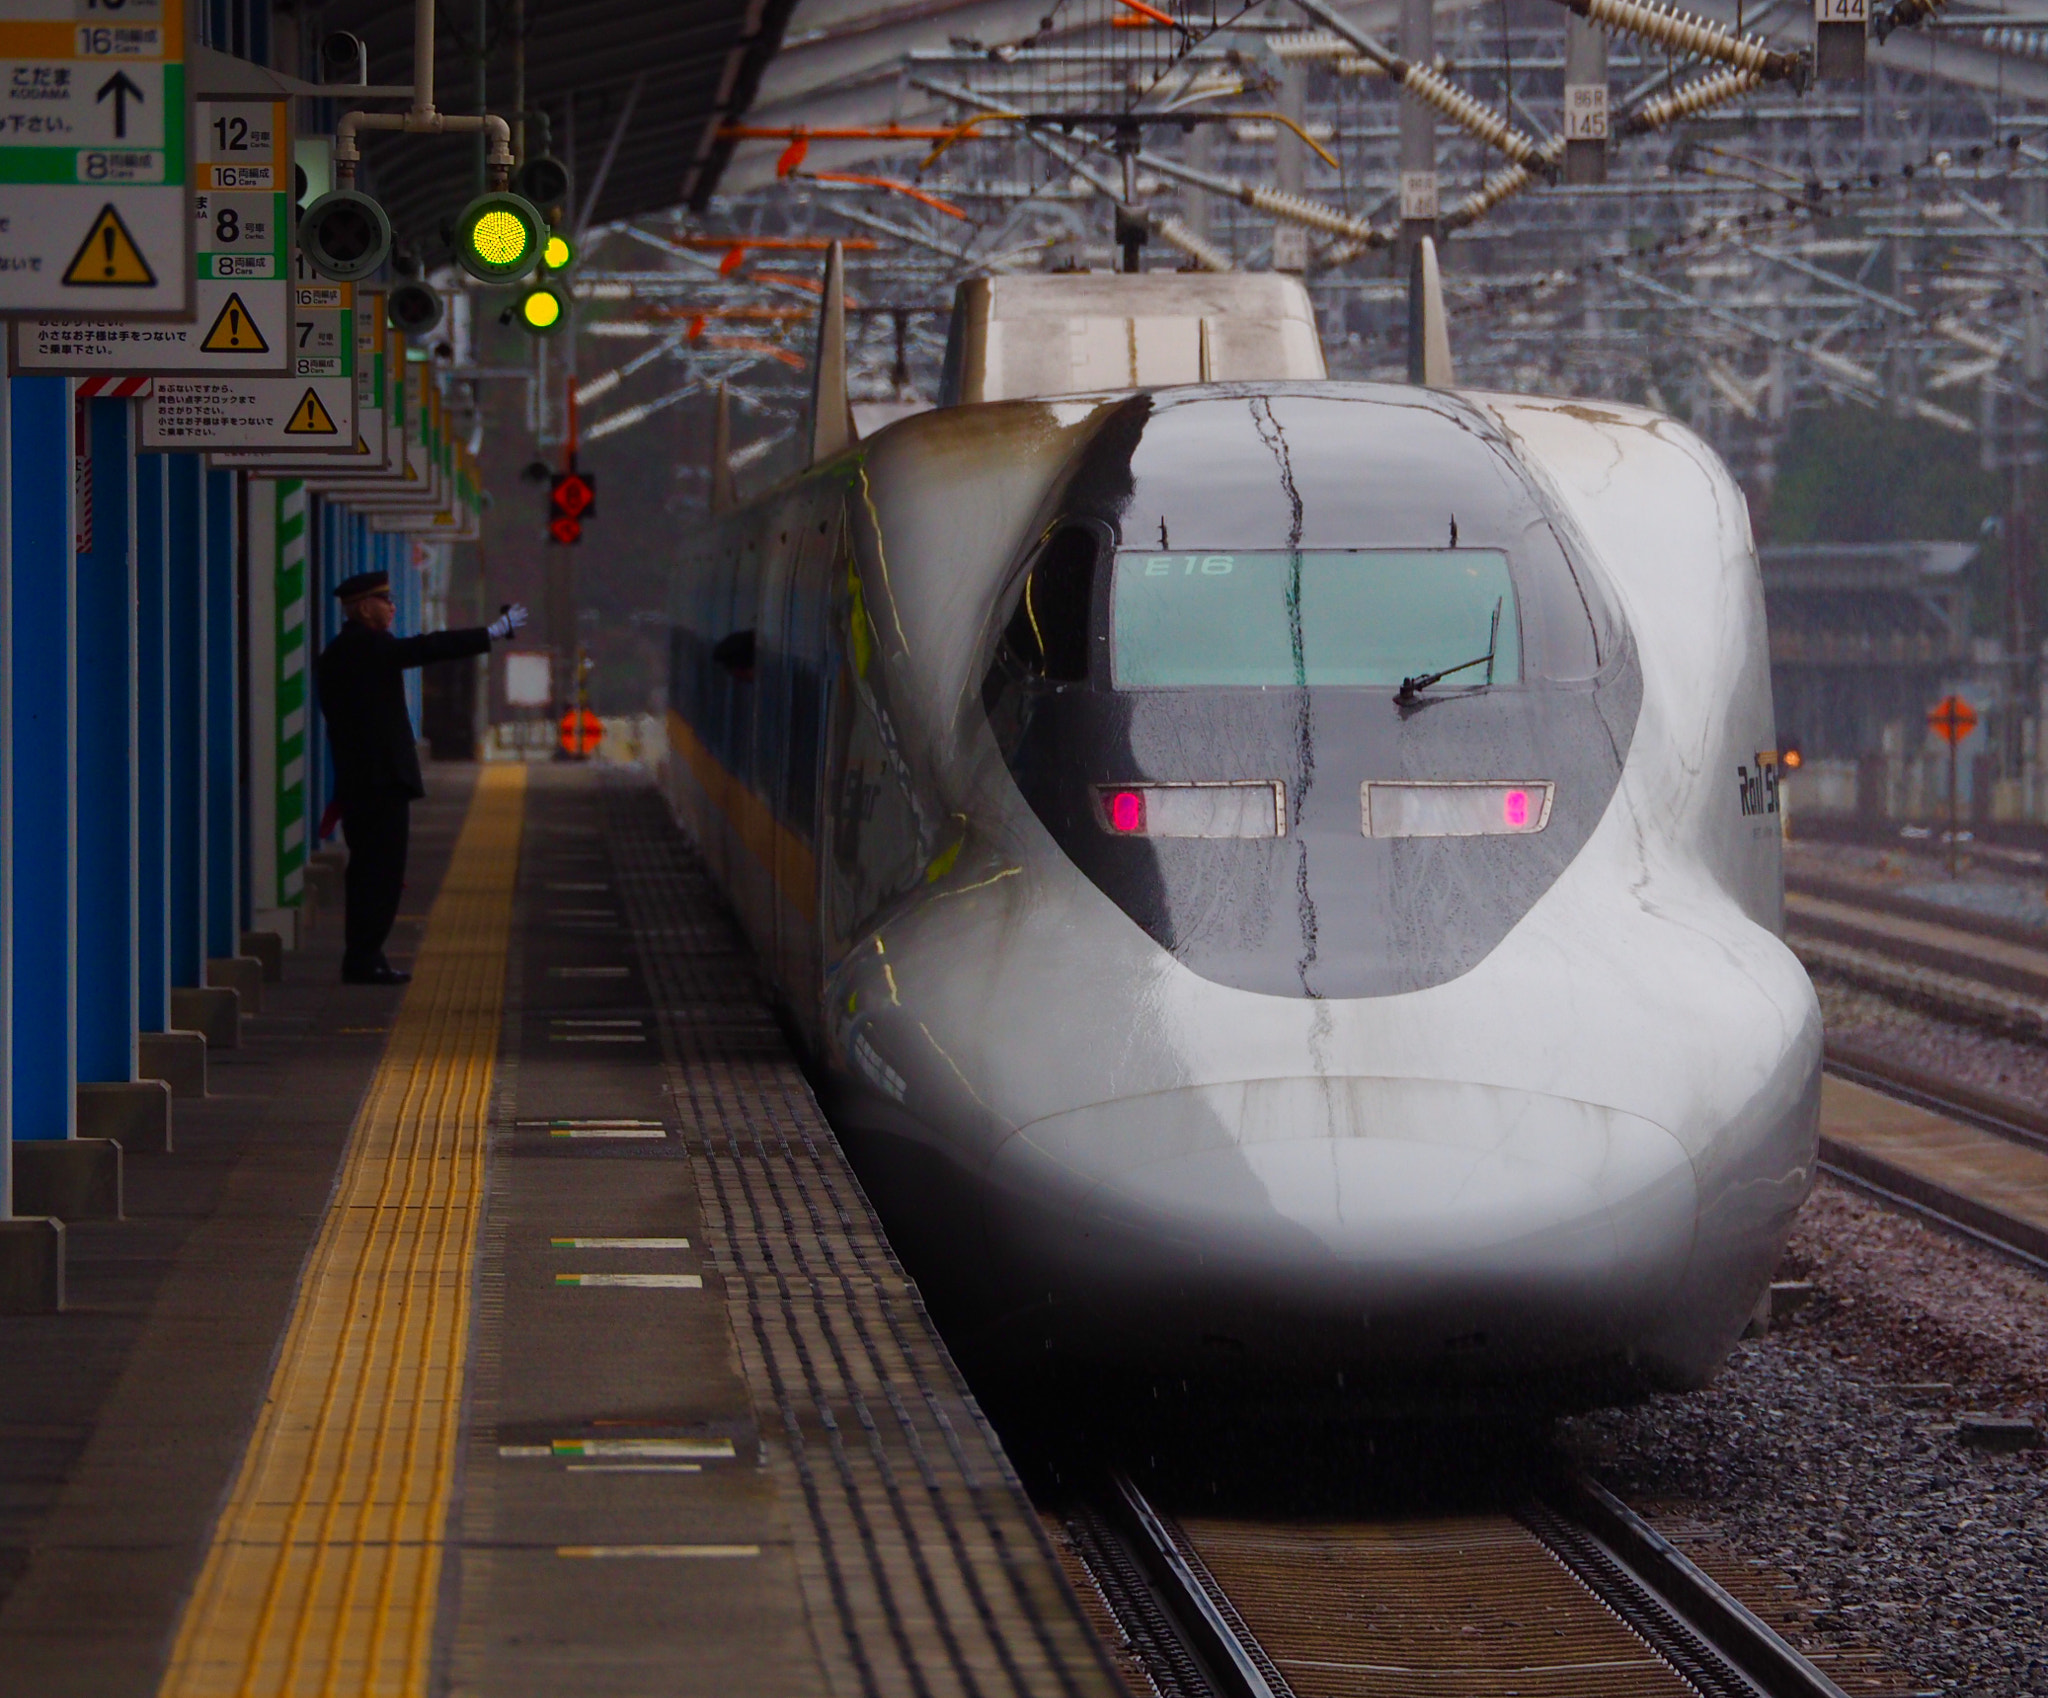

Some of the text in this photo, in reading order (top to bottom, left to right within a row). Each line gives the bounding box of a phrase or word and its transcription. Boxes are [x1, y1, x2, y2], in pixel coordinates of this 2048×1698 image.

[80, 28, 111, 54] 16
[13, 67, 70, 86] こだま
[11, 90, 70, 100] KODAMA
[1570, 112, 1605, 136] 145
[213, 117, 248, 151] 12
[86, 153, 107, 180] 8
[215, 168, 269, 186] 16 両編成
[216, 209, 239, 242] 8
[218, 257, 266, 276] 8 両編成
[296, 290, 311, 304] 16
[38, 331, 187, 342] 小さなお子様は手をつないで
[296, 323, 314, 348] 7
[38, 344, 113, 355] ご乗車下さい。
[297, 360, 310, 374] 8
[158, 417, 274, 426] 小さなお子様は手をつないで
